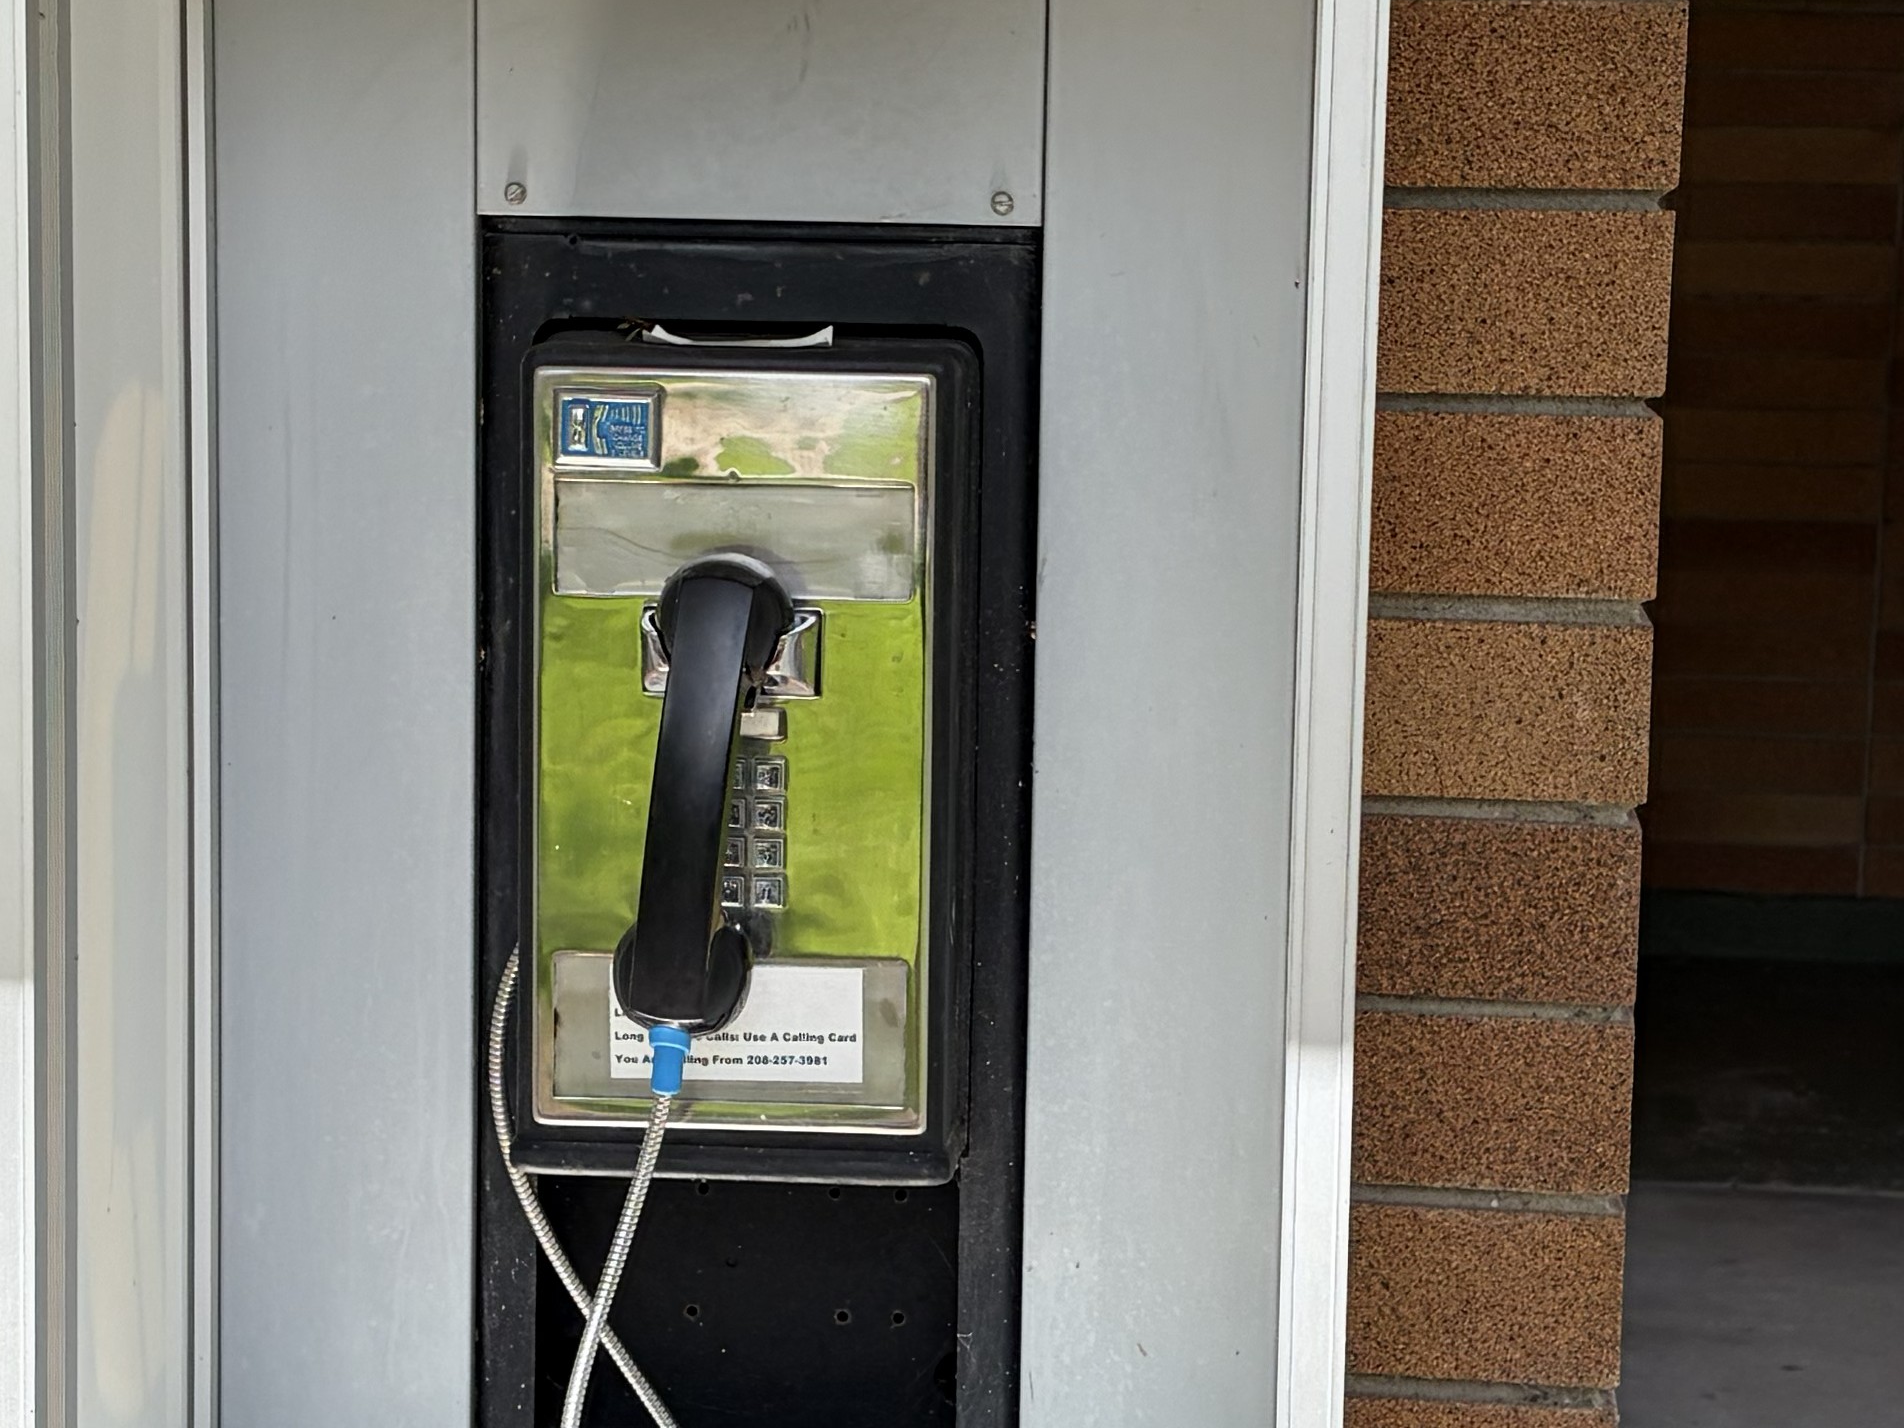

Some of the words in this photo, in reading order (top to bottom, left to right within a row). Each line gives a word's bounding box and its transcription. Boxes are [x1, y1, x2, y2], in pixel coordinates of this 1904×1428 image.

[614, 1031, 644, 1043] Long
[743, 1032, 767, 1042] Use
[770, 1032, 779, 1042] A
[782, 1032, 825, 1045] Calling
[828, 1033, 857, 1043] Card
[615, 1054, 639, 1064] You
[712, 1054, 744, 1065] From
